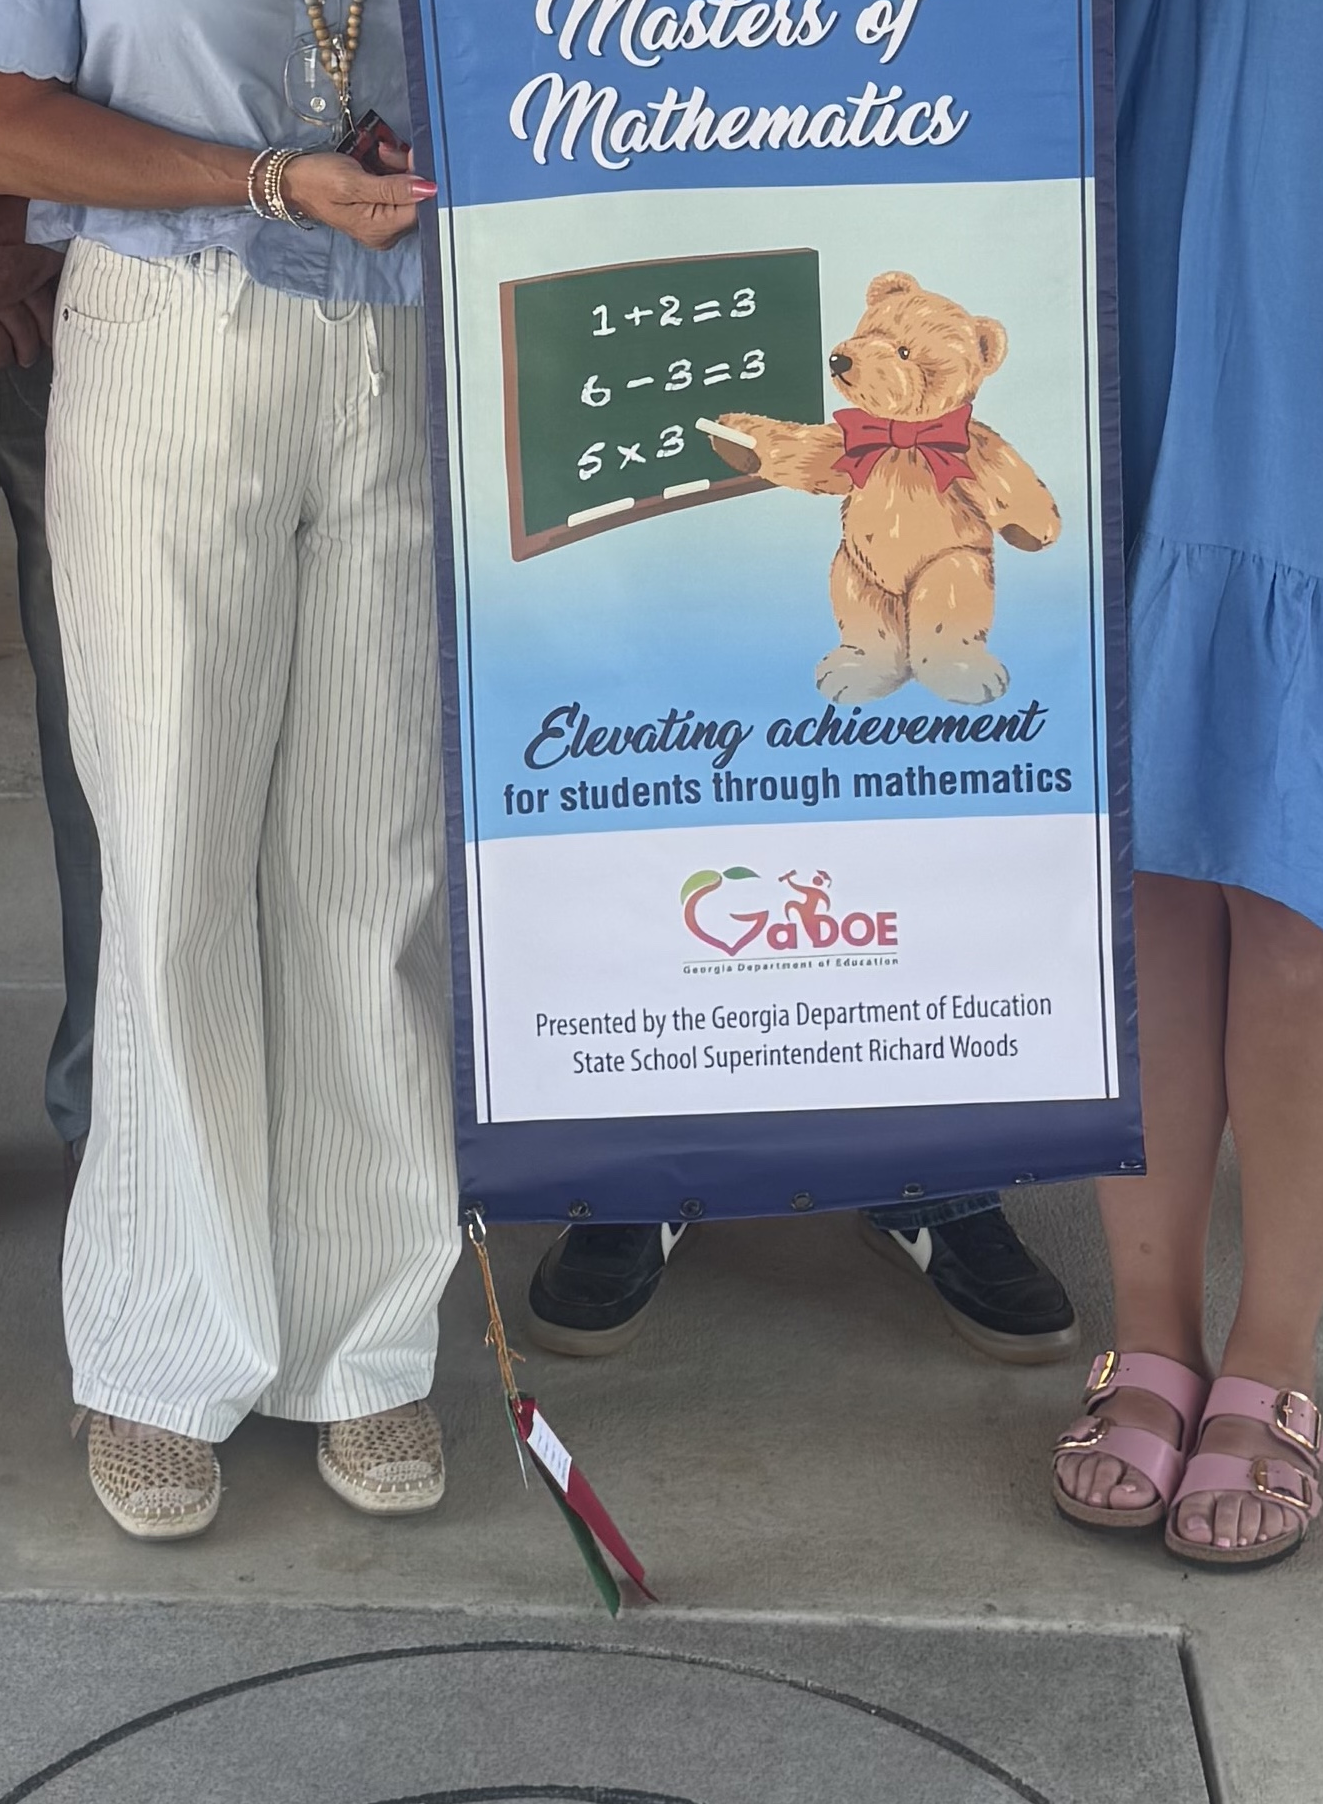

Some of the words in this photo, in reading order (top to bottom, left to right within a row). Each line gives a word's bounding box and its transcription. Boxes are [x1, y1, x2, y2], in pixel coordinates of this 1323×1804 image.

[510, 73, 968, 169] Mathematics
[524, 702, 754, 769] Elevating
[767, 700, 1049, 747] achievement
[504, 784, 549, 815] for
[560, 775, 701, 811] students
[712, 768, 840, 806] through
[854, 763, 1071, 797] mathematics
[683, 963, 733, 975] Georgia
[737, 960, 813, 973] Department
[818, 957, 831, 969] of
[835, 956, 899, 969] Education
[537, 1009, 636, 1036] Presented
[643, 1009, 666, 1038] by
[673, 1007, 705, 1031] the
[712, 1004, 789, 1033] Georgia
[797, 1000, 920, 1030] Department
[927, 995, 947, 1020] of
[953, 995, 1051, 1018] Education
[574, 1051, 624, 1073] State
[631, 1046, 696, 1071] School
[704, 1040, 863, 1073] Superintendent
[870, 1036, 944, 1061] Richard
[950, 1033, 1018, 1058] Woods
